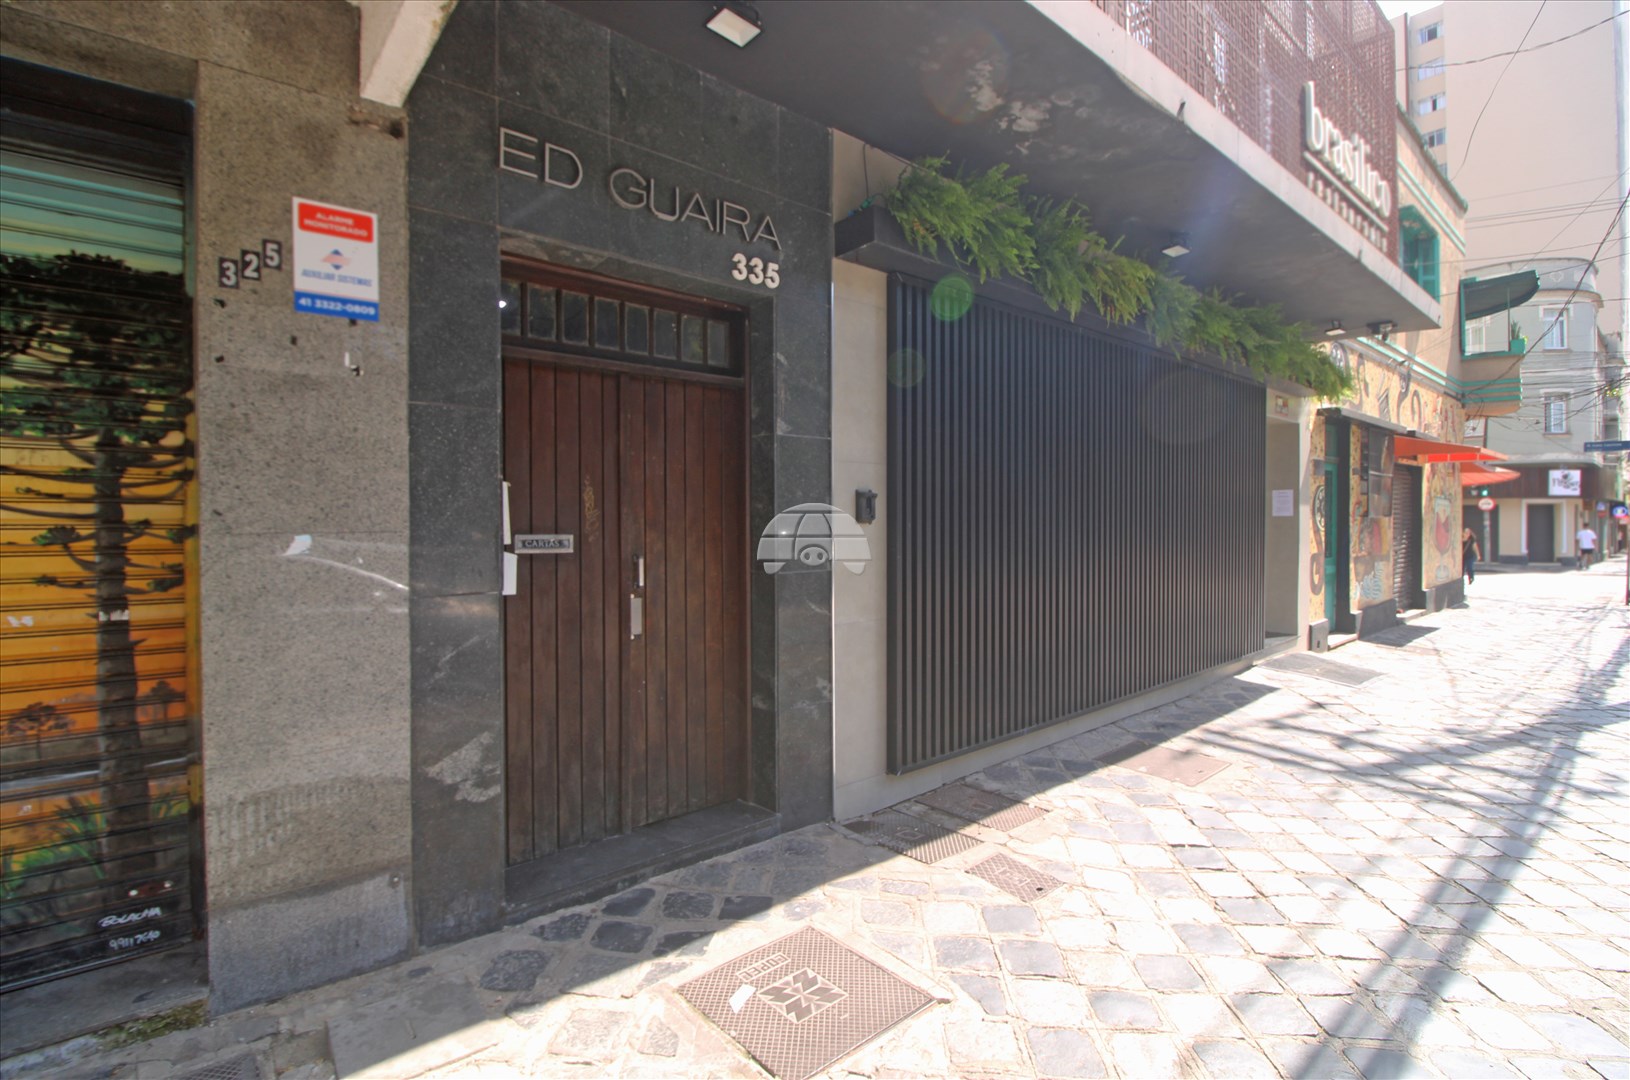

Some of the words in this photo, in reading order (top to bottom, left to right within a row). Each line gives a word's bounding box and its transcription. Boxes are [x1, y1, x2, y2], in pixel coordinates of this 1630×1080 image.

[500, 127, 583, 189] ED
[610, 168, 782, 250] GUAIRA
[303, 218, 368, 237] MONITORADO
[731, 253, 780, 289] 335
[525, 540, 560, 548] CARTAS
[739, 954, 788, 978] COPEL
